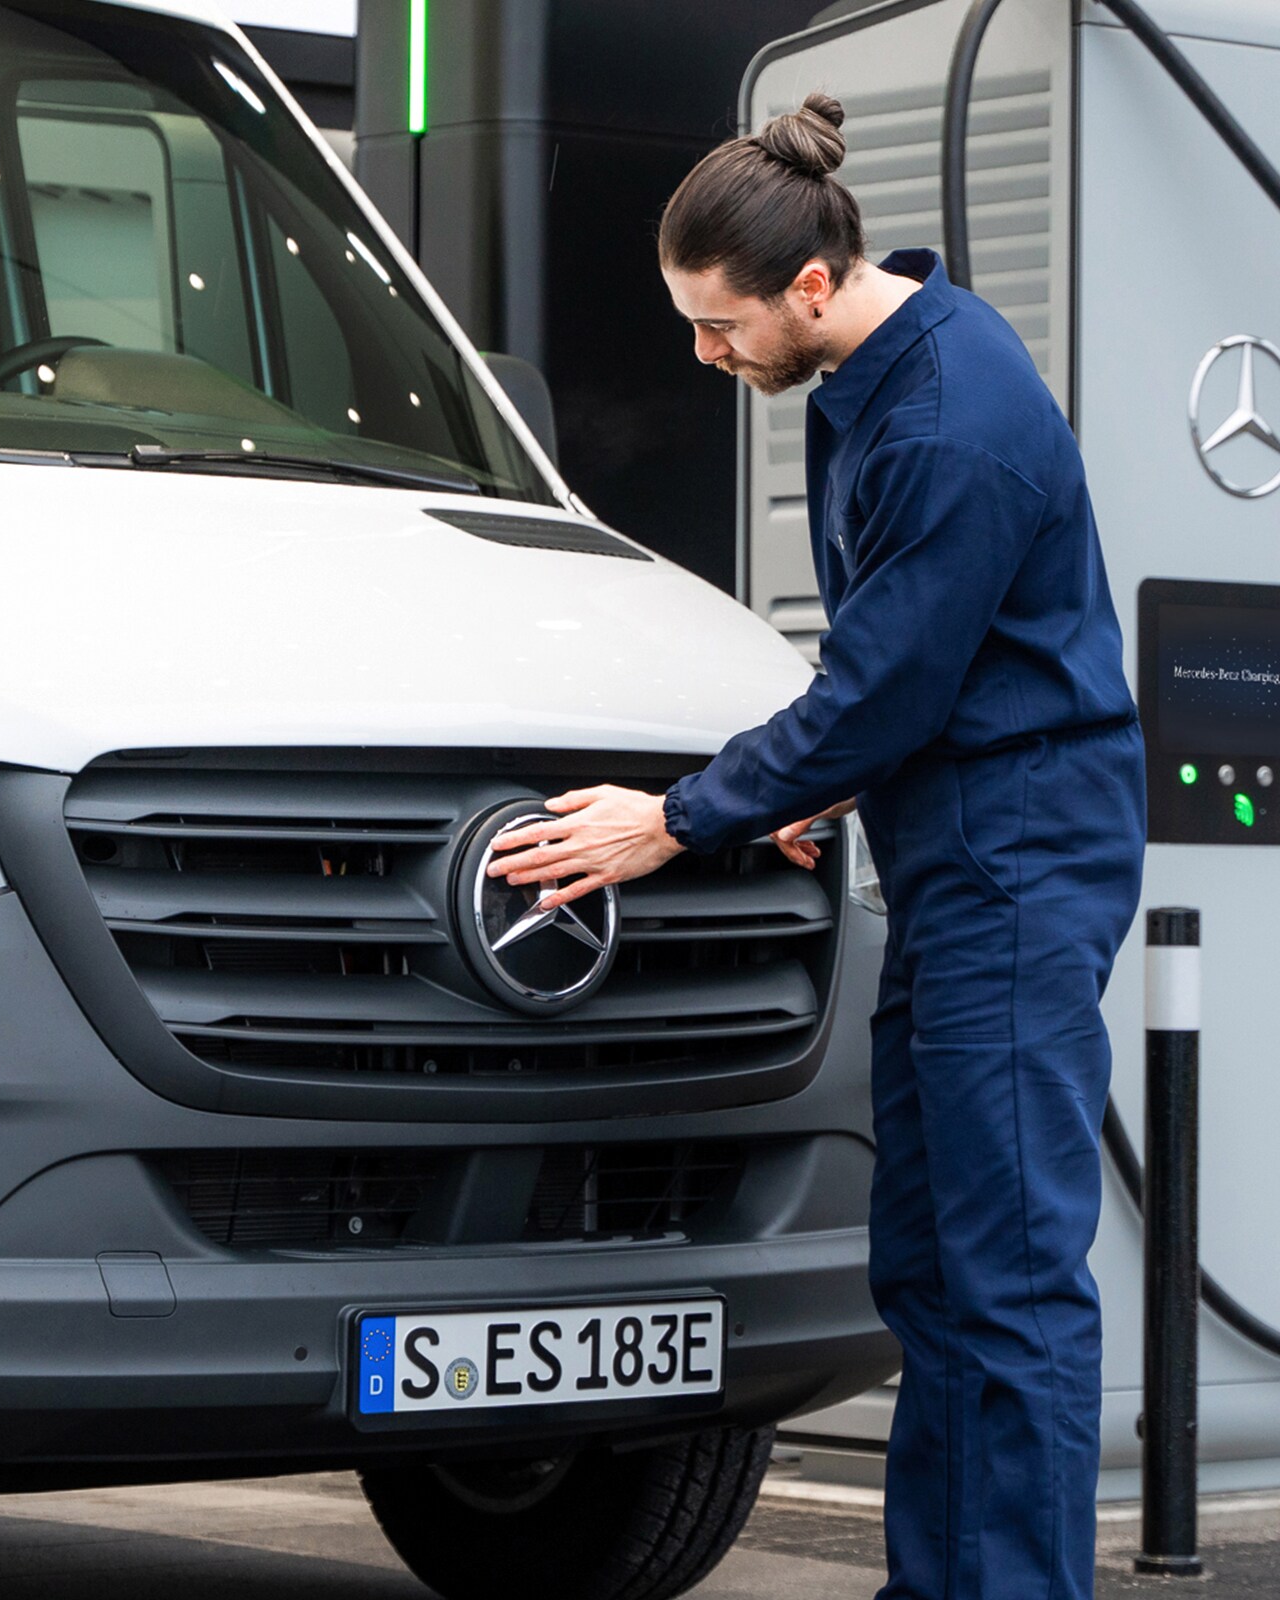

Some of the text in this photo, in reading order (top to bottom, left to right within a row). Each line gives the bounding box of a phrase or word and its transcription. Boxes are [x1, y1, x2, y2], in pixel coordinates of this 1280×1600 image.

[1174, 665, 1240, 681] Mercedes-Benz
[1241, 669, 1280, 685] Charging
[401, 1326, 440, 1400] S
[369, 1374, 384, 1396] D
